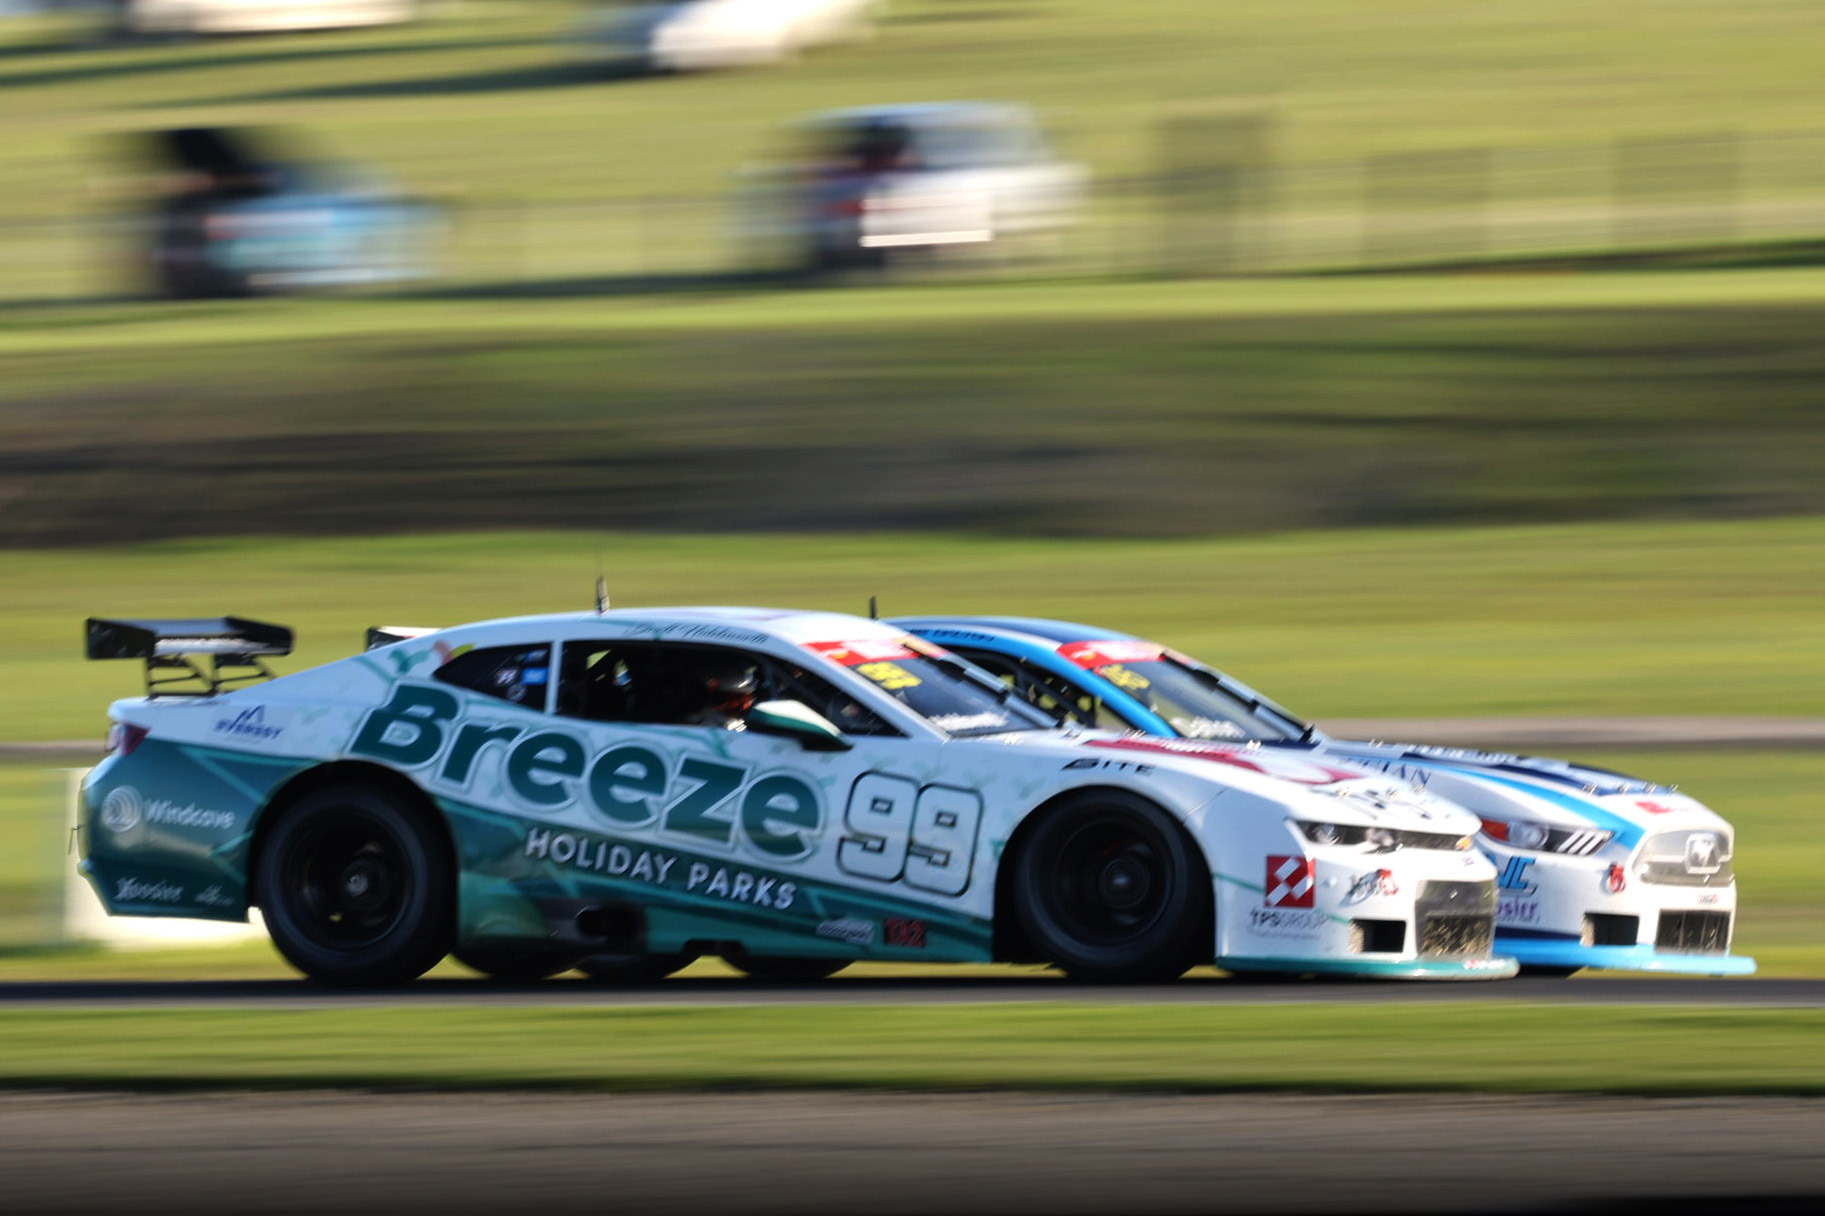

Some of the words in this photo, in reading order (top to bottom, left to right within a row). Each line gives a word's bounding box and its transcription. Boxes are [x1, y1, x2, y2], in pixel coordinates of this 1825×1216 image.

[144, 799, 236, 829] Windcave
[350, 684, 820, 858] Breeze
[525, 829, 677, 884] HOLIDAY
[688, 862, 797, 911] PARKS
[837, 770, 983, 897] 99
